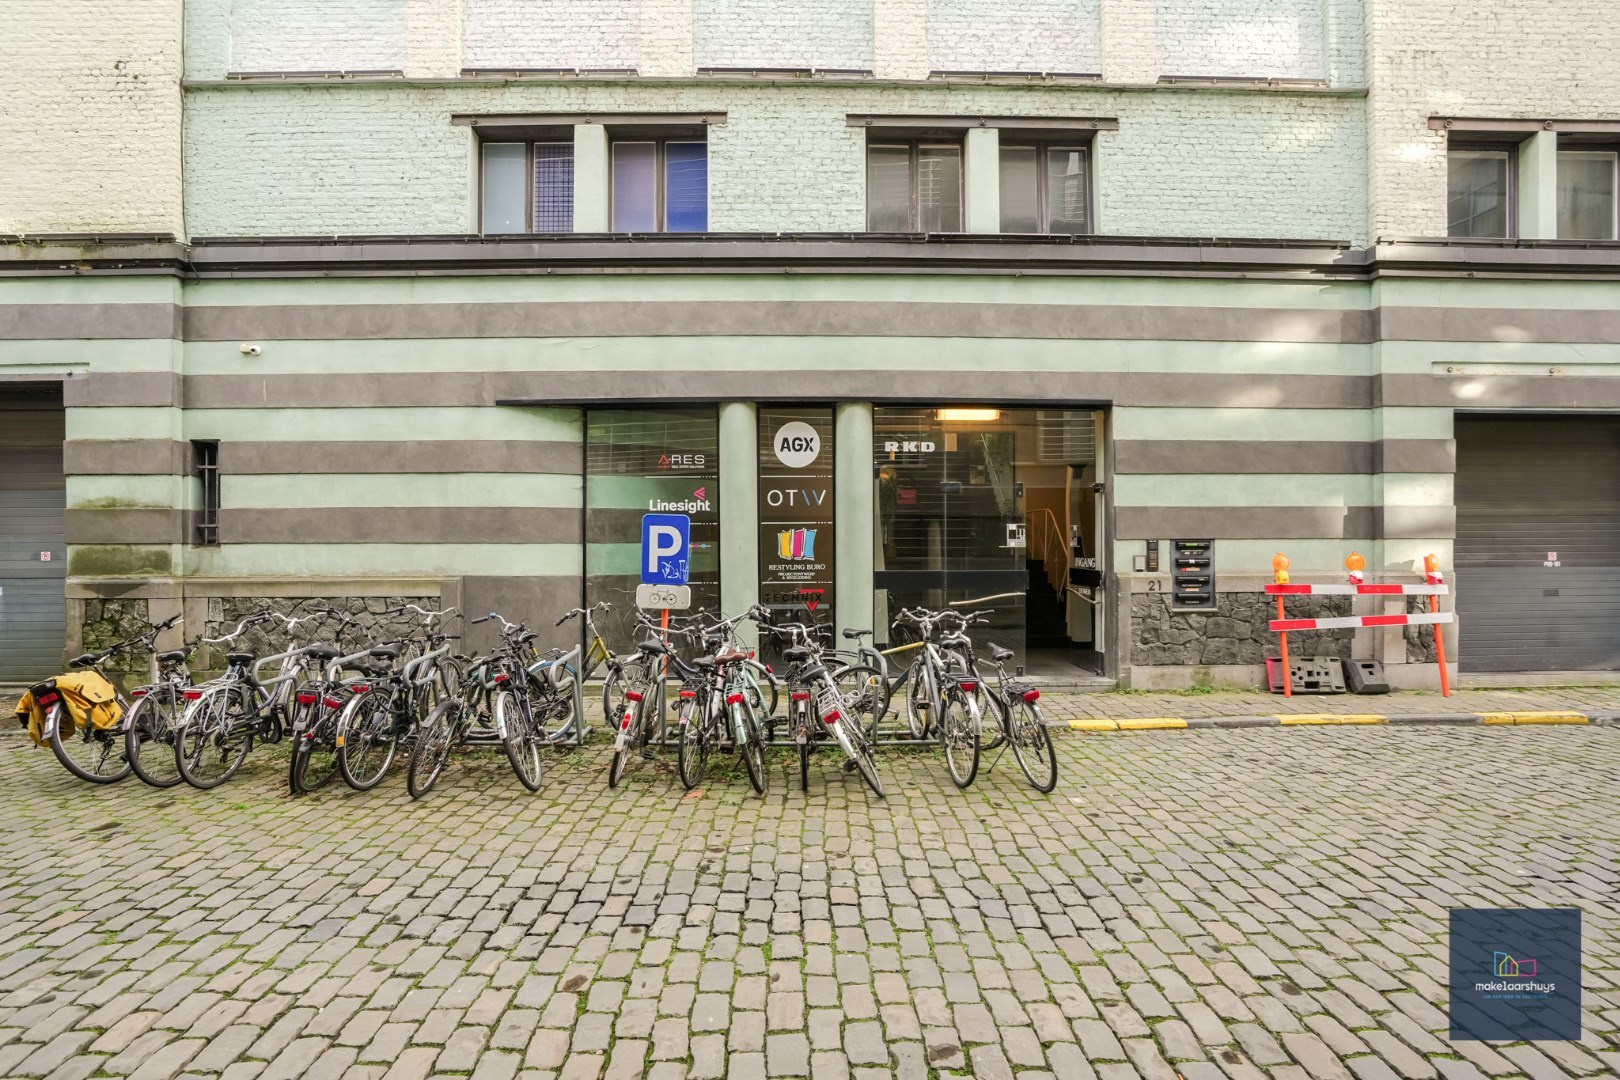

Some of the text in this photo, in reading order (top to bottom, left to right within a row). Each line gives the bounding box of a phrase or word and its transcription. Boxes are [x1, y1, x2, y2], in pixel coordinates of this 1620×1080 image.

[780, 437, 814, 452] AGX
[884, 441, 935, 452] RKD
[649, 498, 711, 514] Linesight
[648, 525, 683, 573] P
[1075, 557, 1096, 568] INGANG
[1148, 580, 1162, 591] 21
[764, 593, 822, 602] TECHNIX
